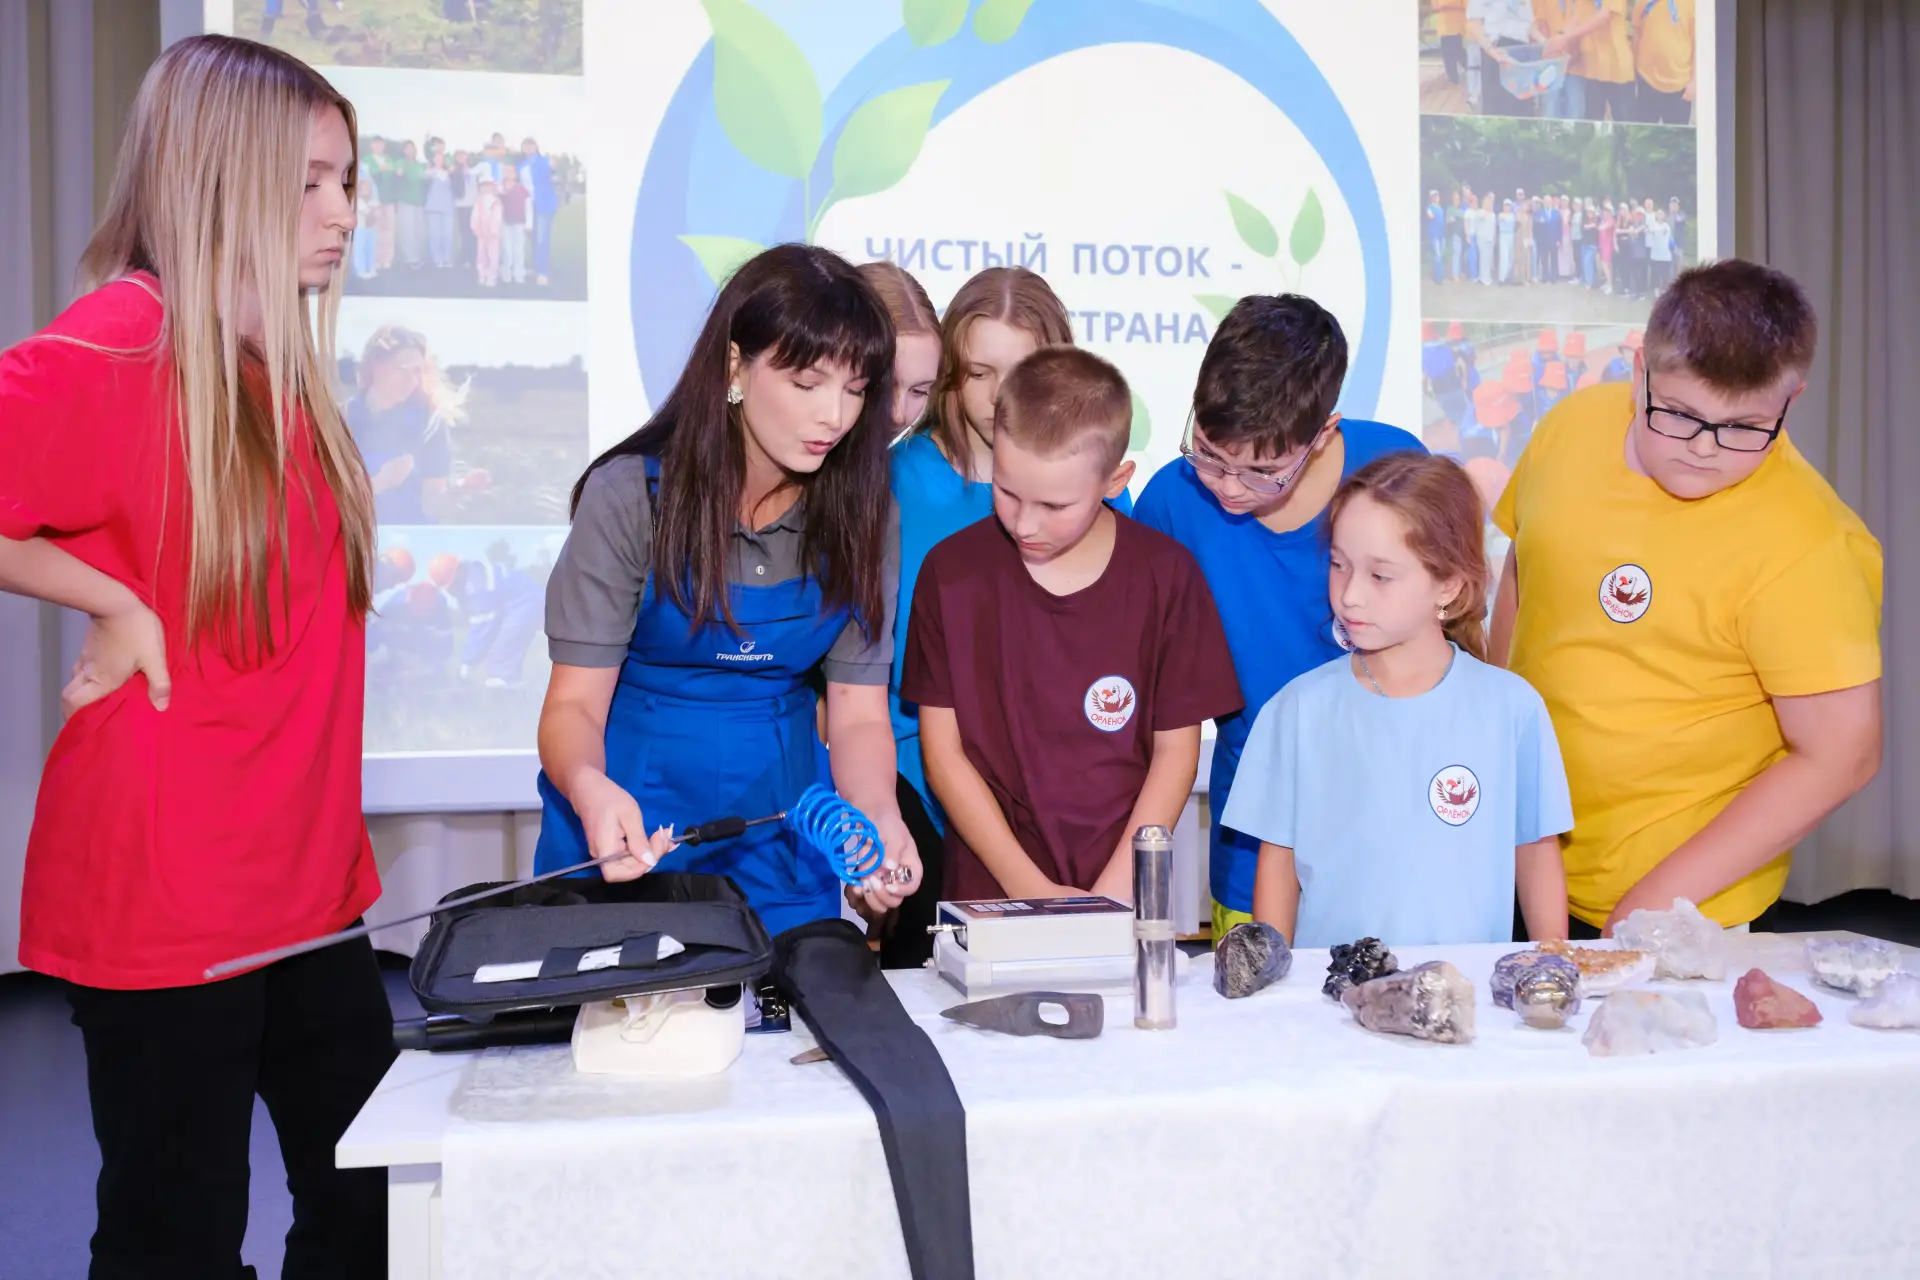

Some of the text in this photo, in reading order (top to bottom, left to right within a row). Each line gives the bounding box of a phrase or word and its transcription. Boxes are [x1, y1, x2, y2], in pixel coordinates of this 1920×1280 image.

[865, 232, 1047, 273] ЧИСТЫЙ
[1073, 243, 1211, 278] ПОТОК
[716, 653, 774, 661] ТРАНСНЕФТЬ
